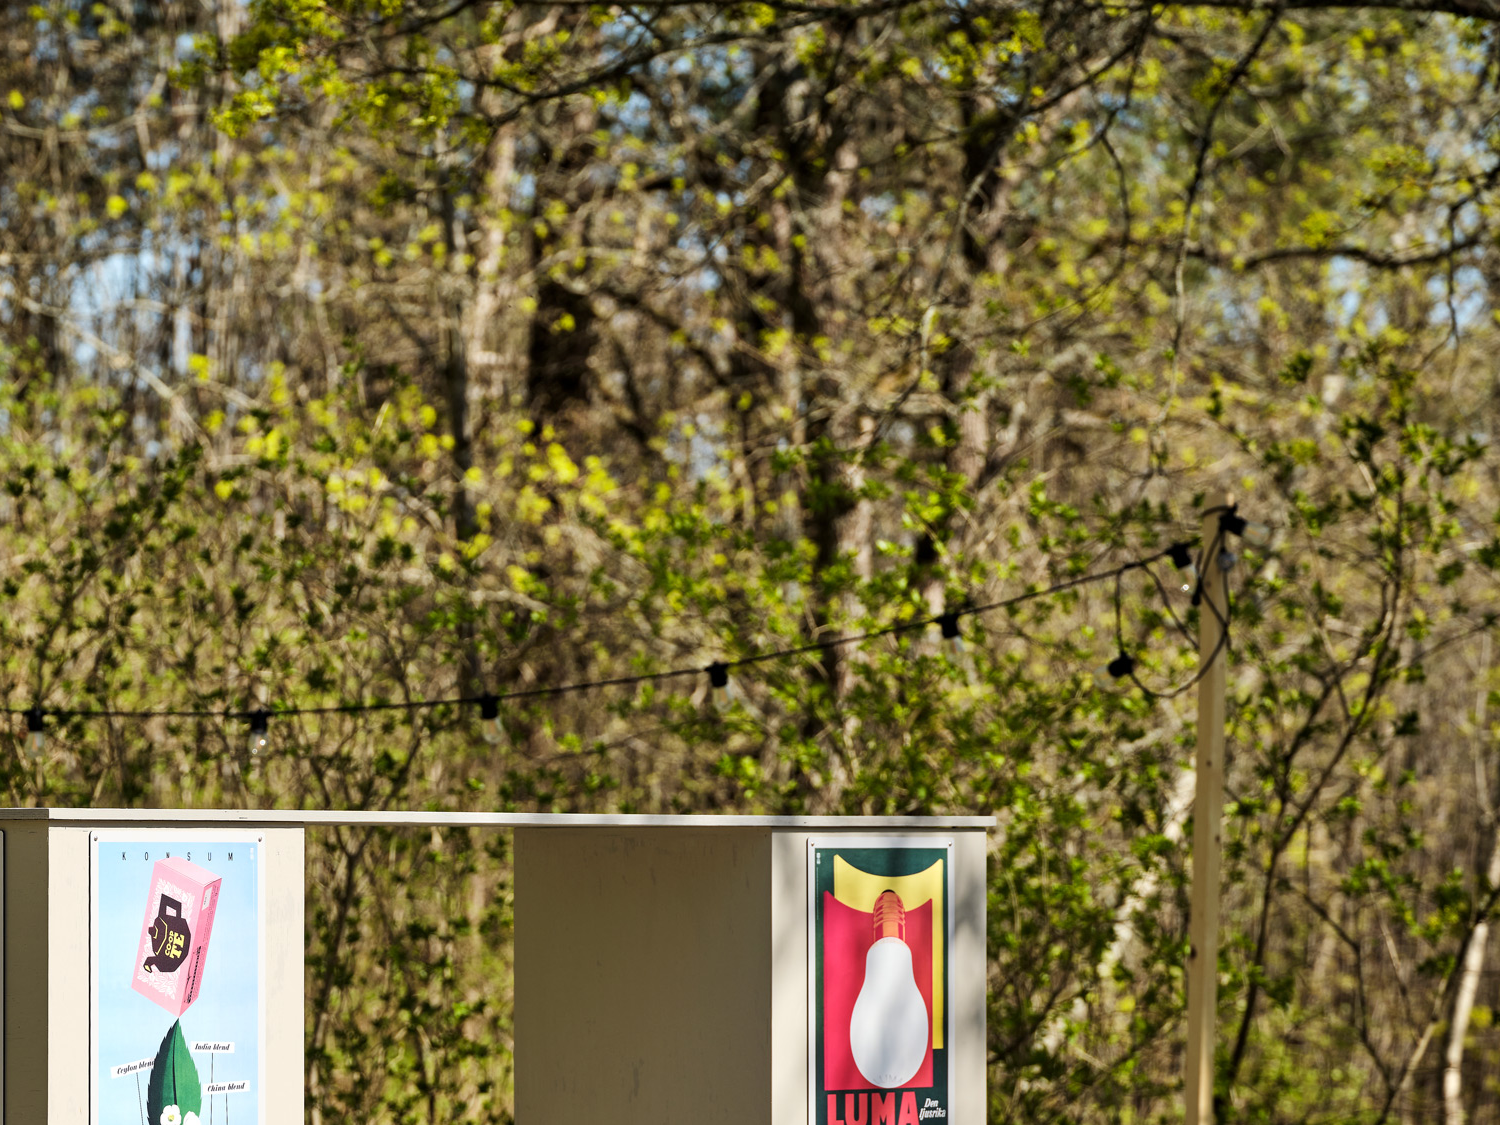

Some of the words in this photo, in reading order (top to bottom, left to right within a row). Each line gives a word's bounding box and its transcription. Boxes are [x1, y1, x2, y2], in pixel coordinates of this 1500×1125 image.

[122, 852, 233, 861] KONSUM
[169, 932, 185, 959] TE
[207, 1084, 226, 1093] China
[924, 1098, 939, 1108] Den
[919, 1108, 946, 1121] ljusrika
